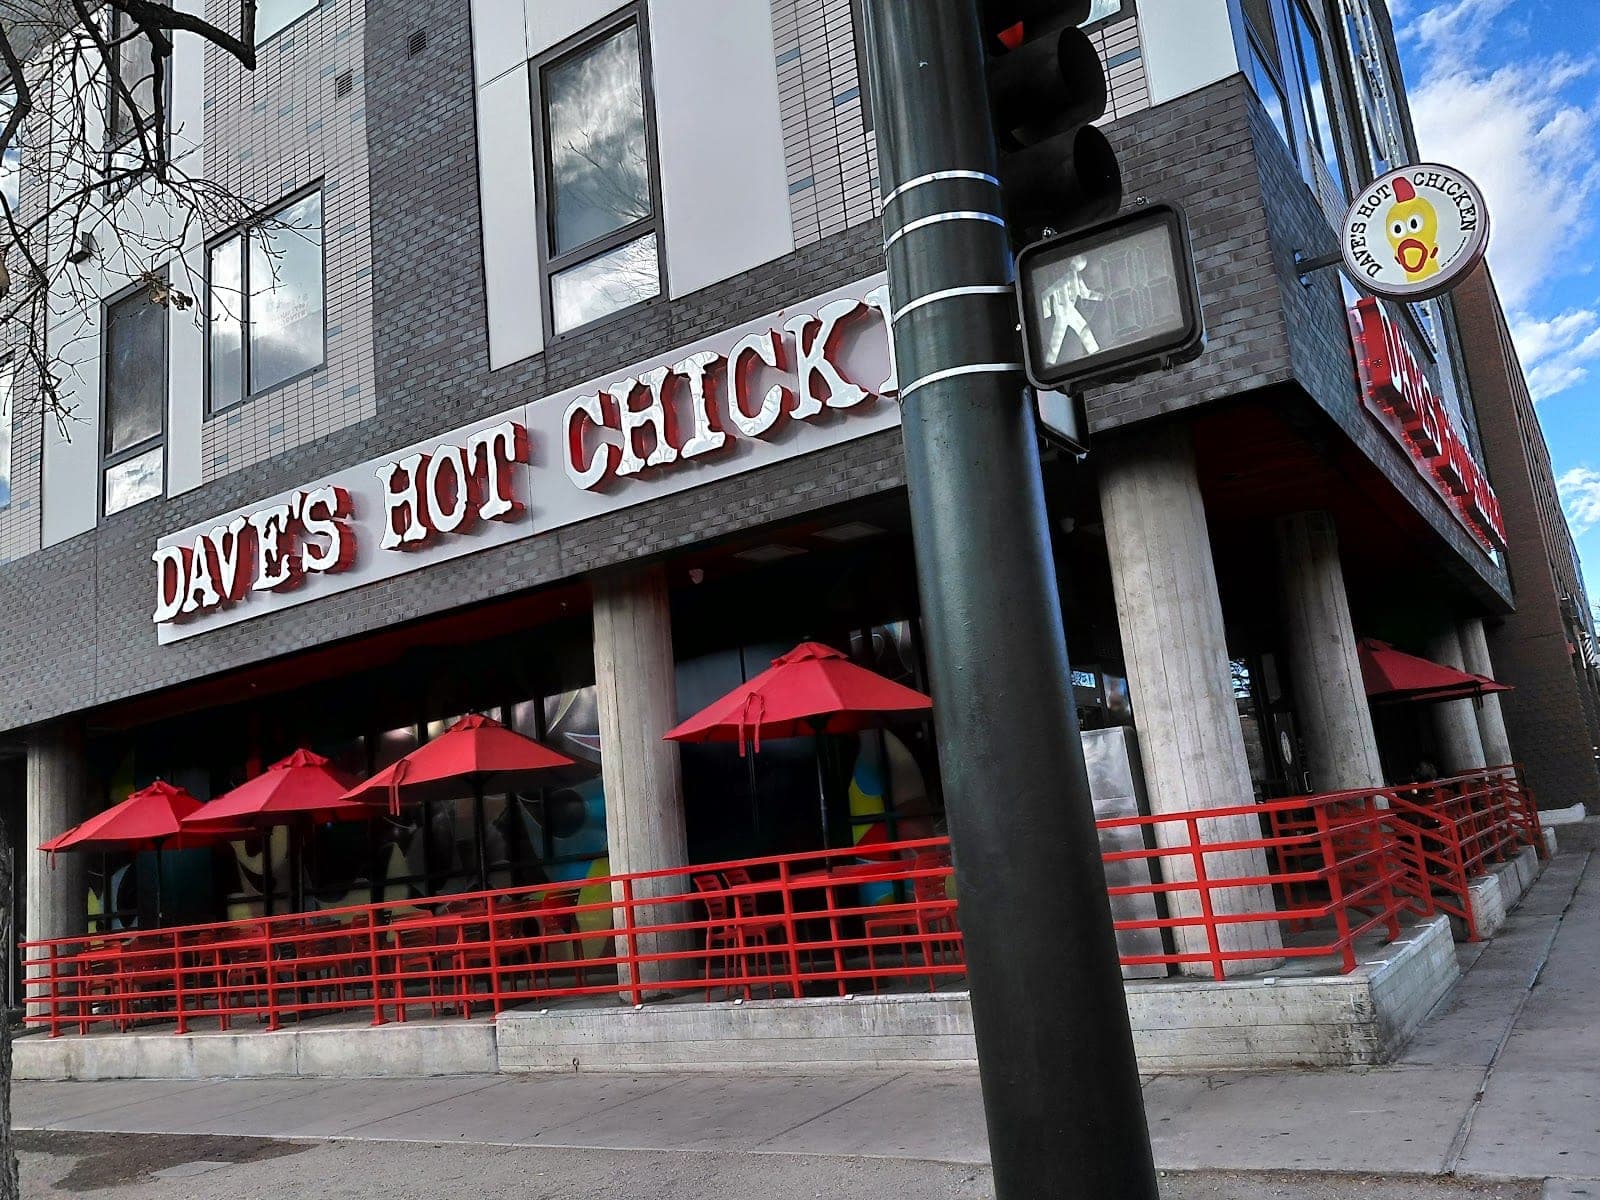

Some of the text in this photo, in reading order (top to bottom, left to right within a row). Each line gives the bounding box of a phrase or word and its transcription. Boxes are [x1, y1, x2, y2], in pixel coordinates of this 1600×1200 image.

[1357, 184, 1392, 219] HOT
[1413, 172, 1477, 232] CHICKEN
[1350, 221, 1383, 278] DAVE'S
[151, 484, 342, 624] DAVE'S
[374, 420, 516, 550] HOT
